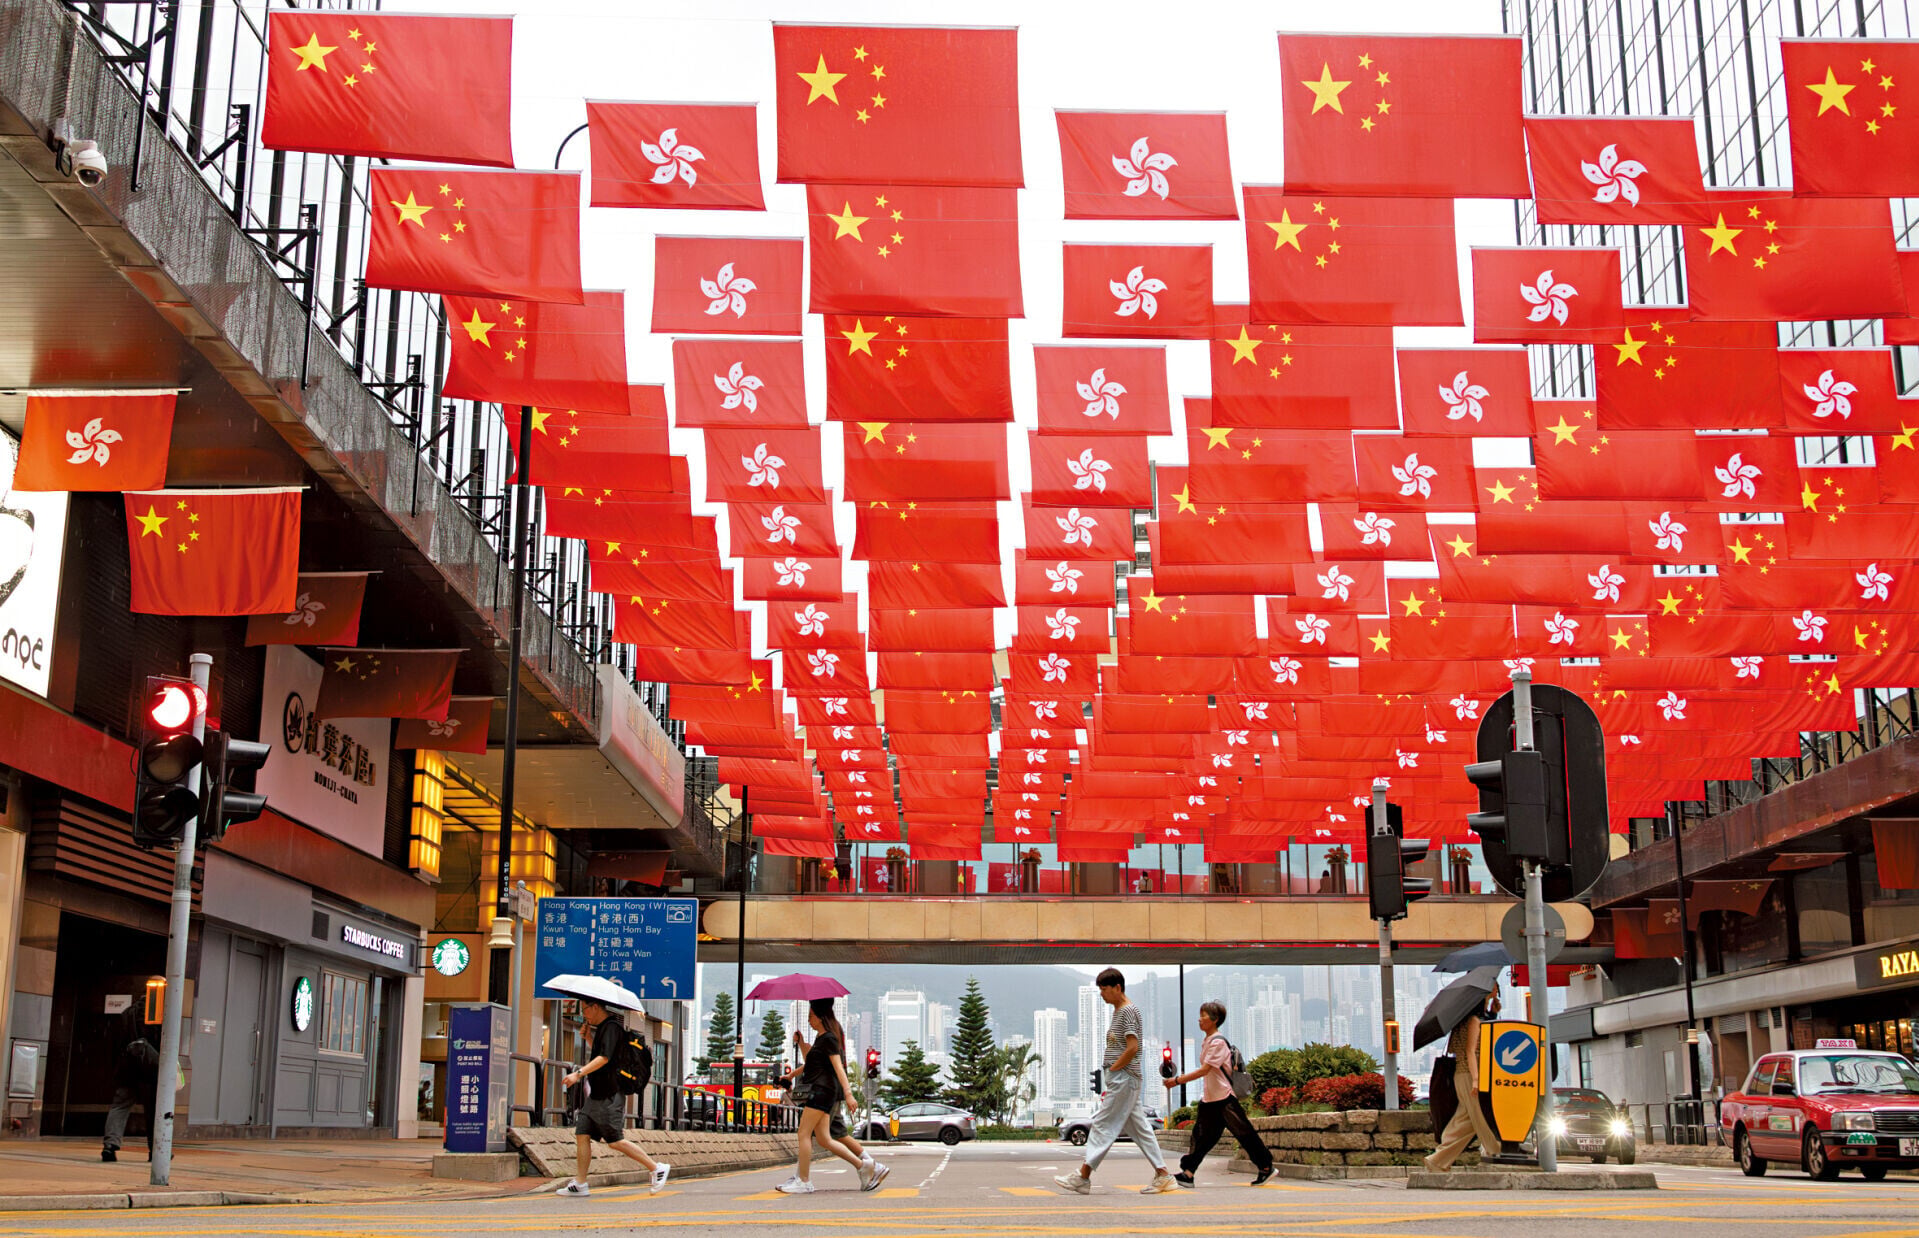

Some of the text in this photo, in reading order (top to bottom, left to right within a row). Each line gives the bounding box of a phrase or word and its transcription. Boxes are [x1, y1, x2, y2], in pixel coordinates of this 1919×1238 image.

[314, 770, 358, 804] MOMIJI-CHAYA
[544, 901, 590, 911] Hong Kong
[599, 901, 667, 911] Hong Kong (W)
[545, 912, 568, 924] 香港
[600, 913, 644, 924] 香港(西)
[543, 924, 588, 935] Kwun Tong
[598, 925, 662, 935] Hung Hom Bay
[343, 925, 404, 959] STARBUCKS COFFEE
[543, 936, 566, 948] 觀塘
[598, 937, 634, 948] 紅磡灣
[598, 949, 652, 957] To Kwa Wan
[598, 961, 633, 972] 土瓜灣
[1879, 950, 1919, 978] RAYA
[1821, 1039, 1854, 1048] TAXI
[1495, 1079, 1535, 1088] 62044
